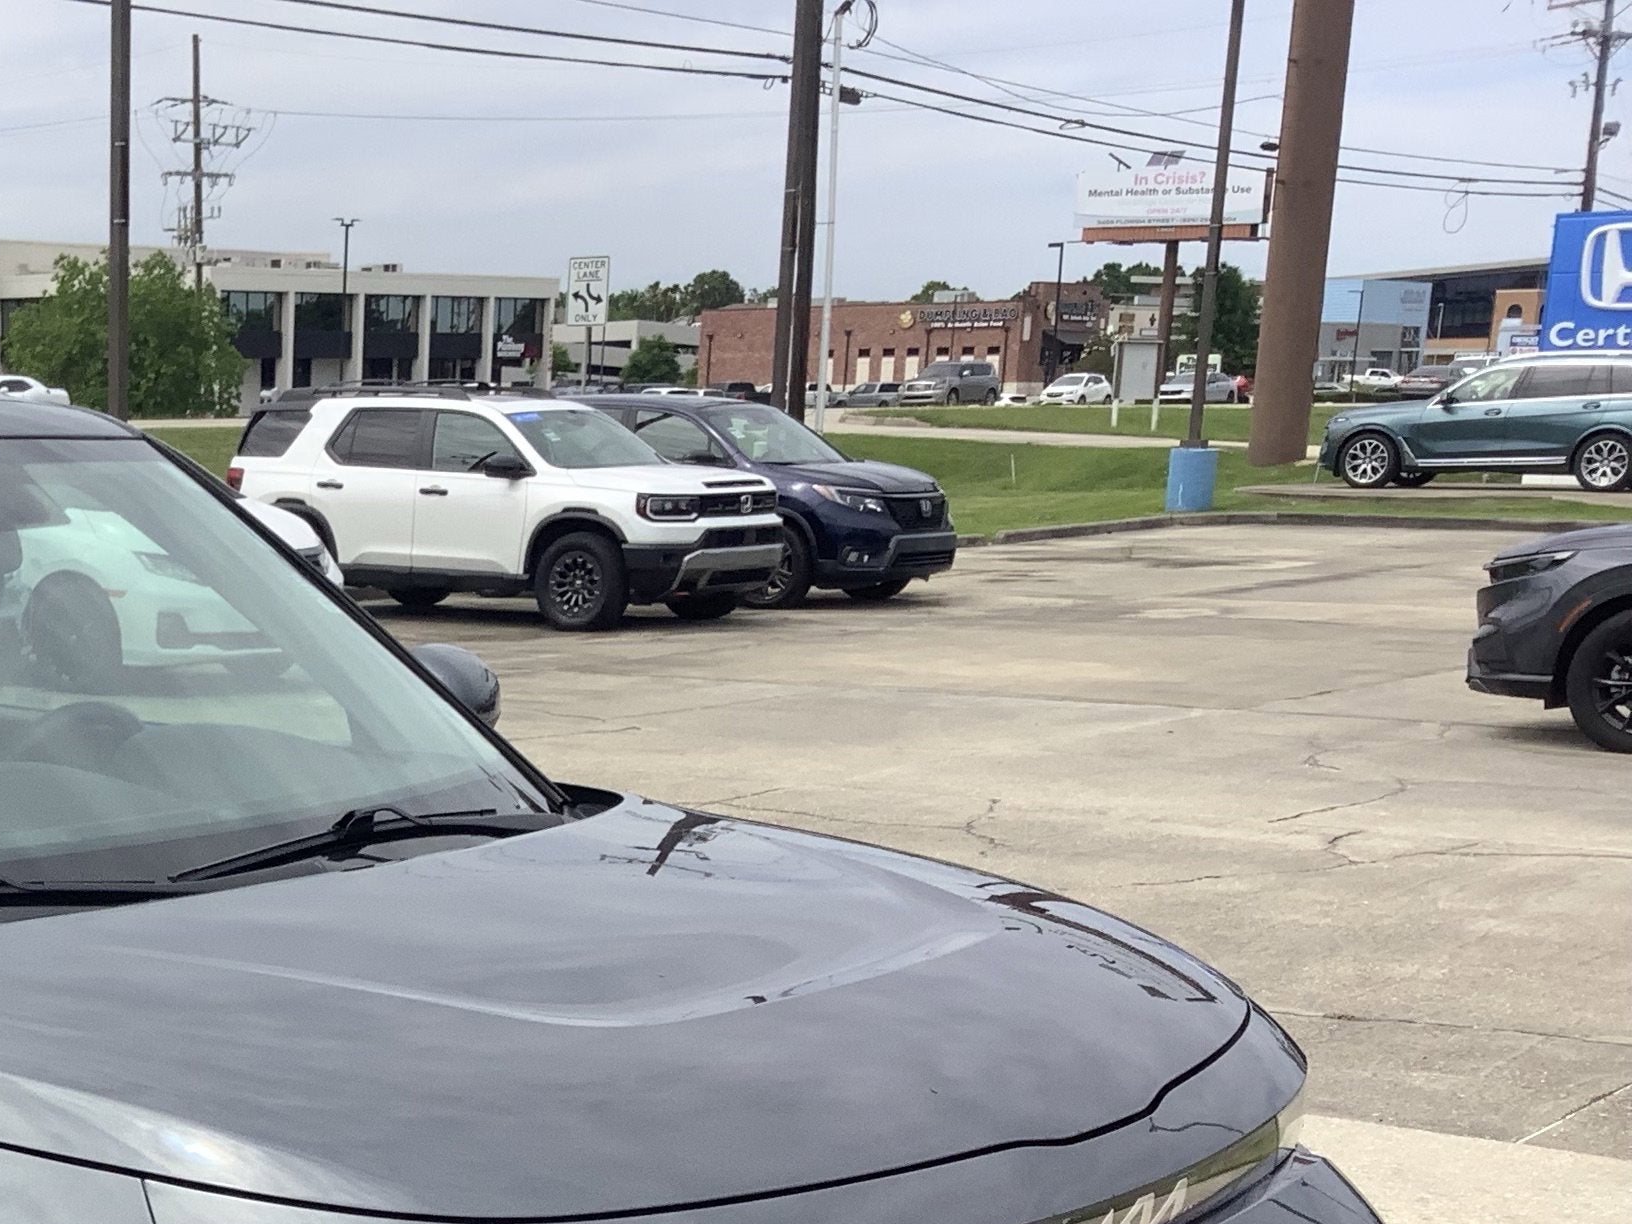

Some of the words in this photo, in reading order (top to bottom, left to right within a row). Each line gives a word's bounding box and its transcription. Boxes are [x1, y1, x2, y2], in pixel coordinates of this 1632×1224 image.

[1134, 173, 1148, 186] In
[1154, 171, 1206, 184] Crisis?
[1088, 189, 1122, 197] Mental
[1125, 187, 1159, 196] Health
[1232, 185, 1252, 194] Use
[572, 260, 606, 270] CENTER
[577, 270, 601, 279] LANE
[574, 314, 598, 322] ONLY
[1549, 321, 1632, 347] Cert
